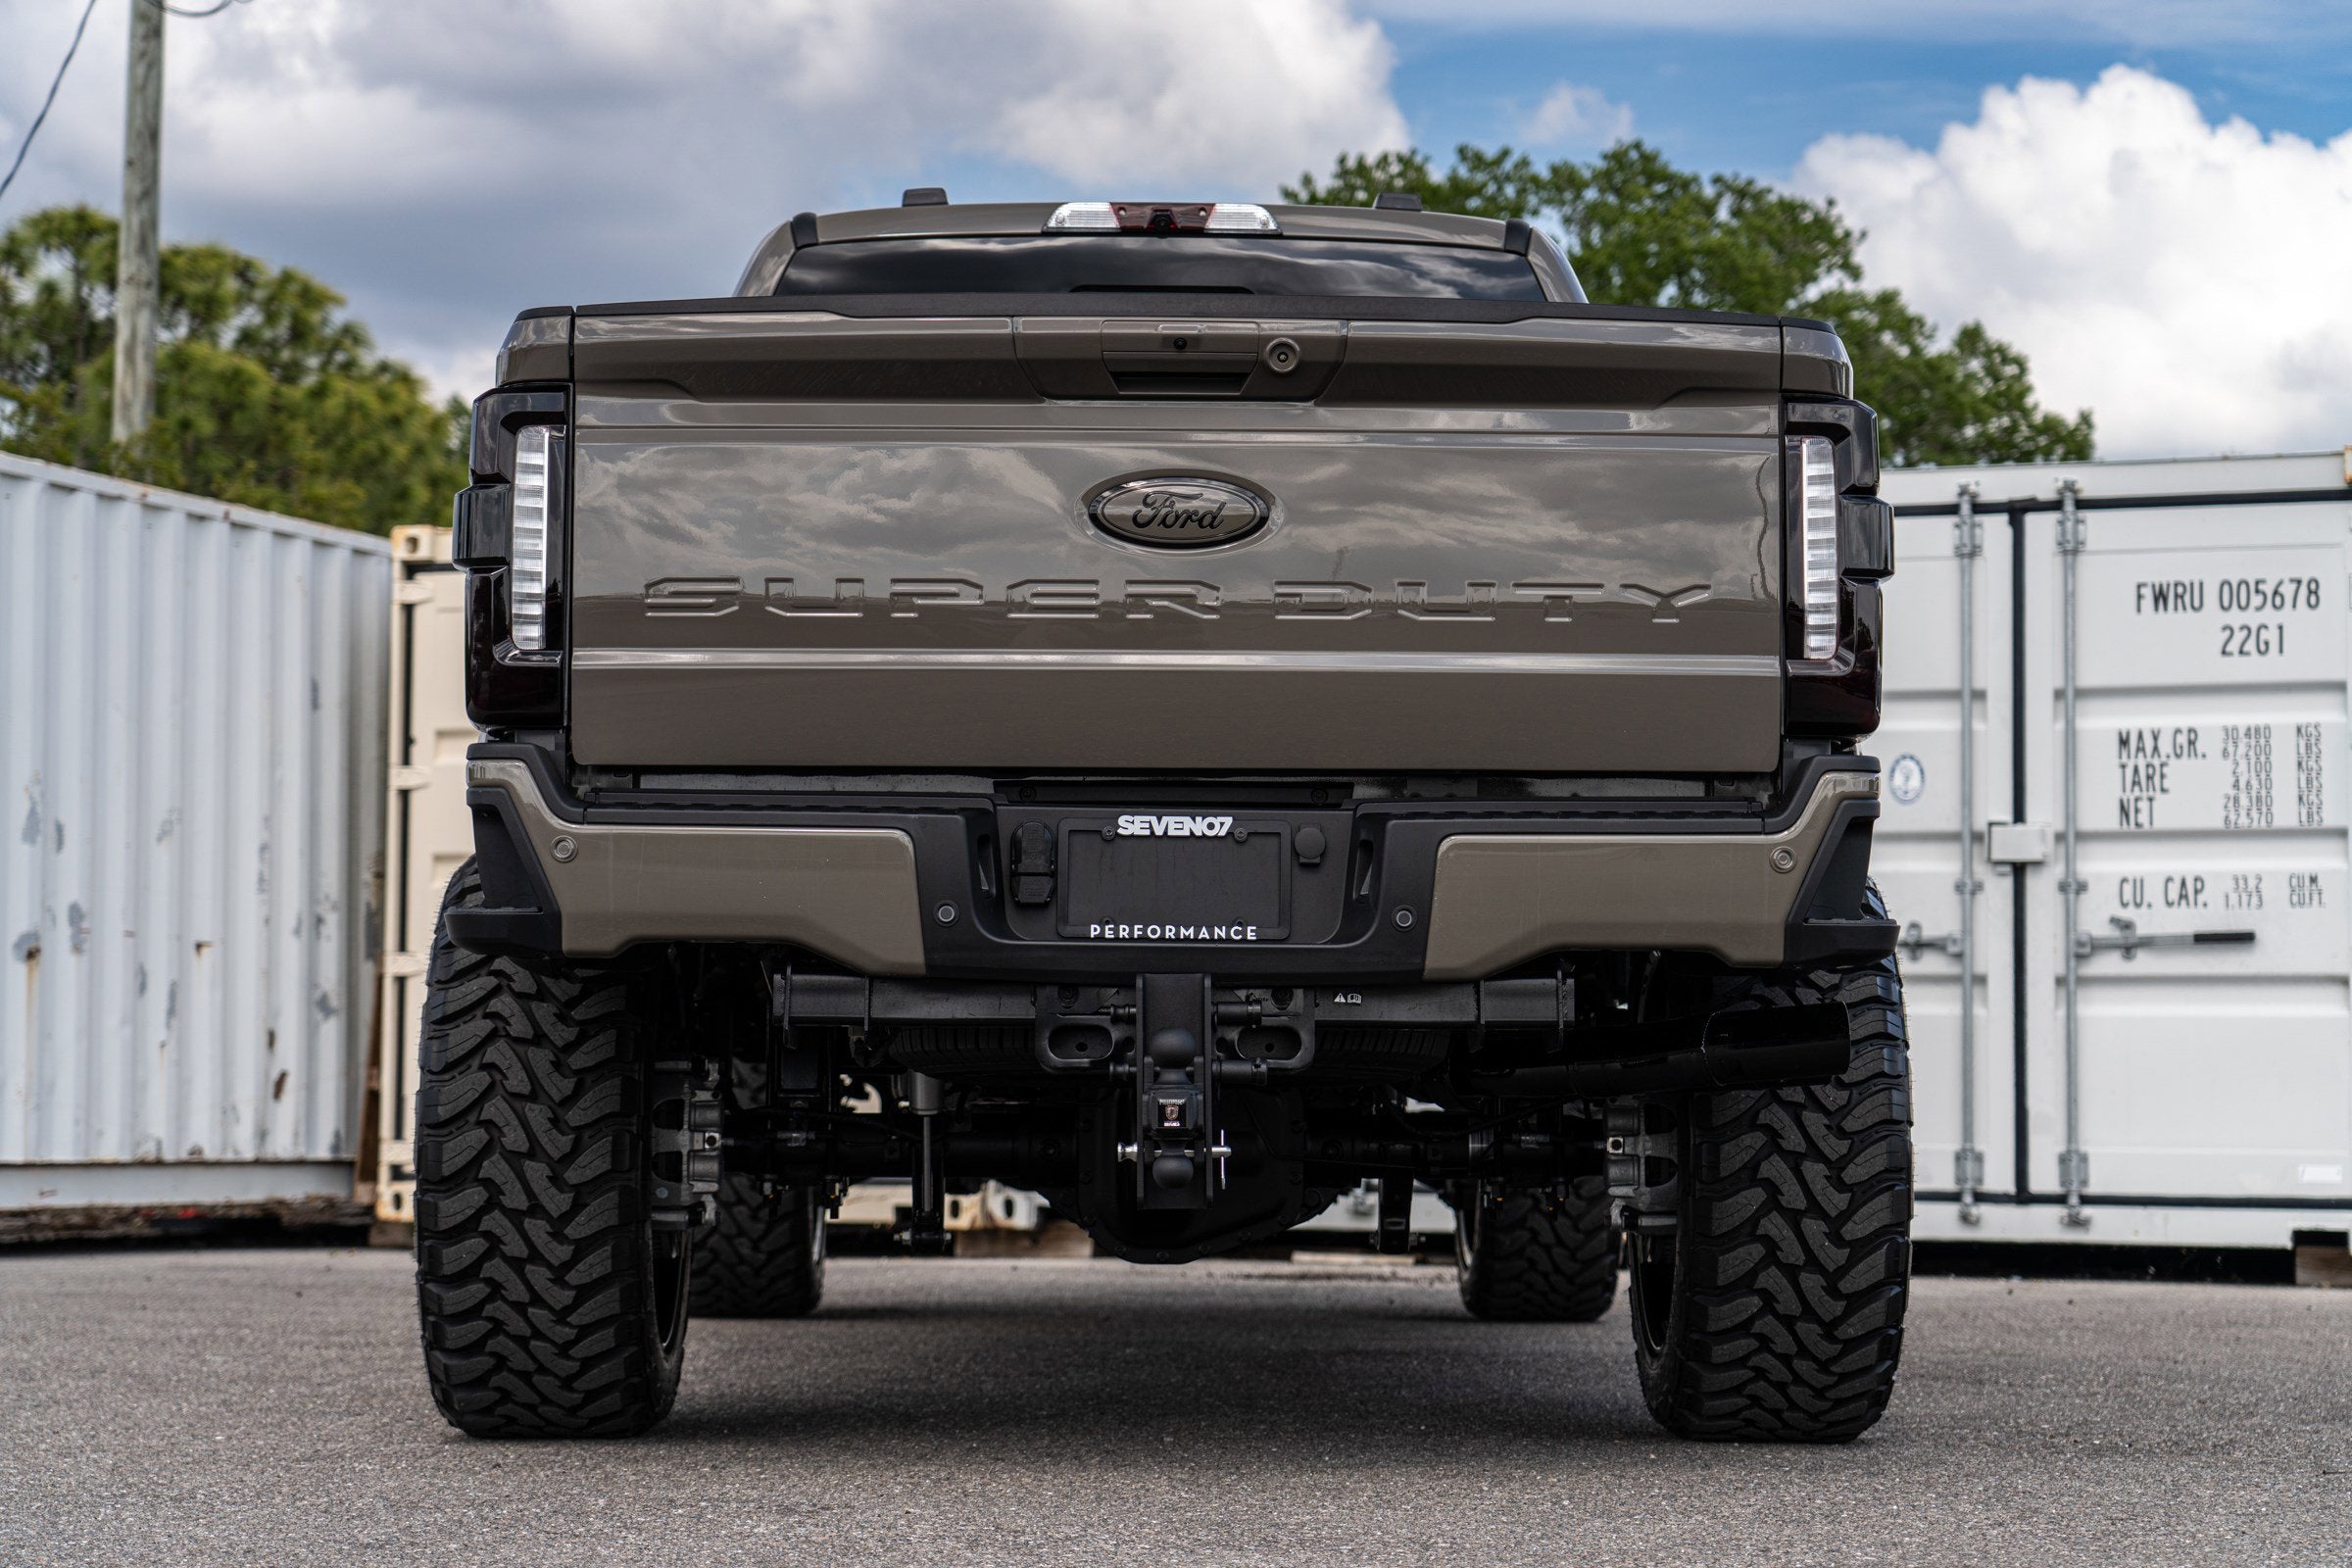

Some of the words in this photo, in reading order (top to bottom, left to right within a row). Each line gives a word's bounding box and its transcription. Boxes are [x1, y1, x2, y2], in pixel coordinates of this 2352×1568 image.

[1132, 490, 1227, 530] Ford
[644, 576, 1222, 618] SUPER
[1274, 580, 1712, 622] DUTY
[2135, 580, 2204, 614] FWRU
[2218, 577, 2321, 612] 005678
[2220, 623, 2285, 657] 22G1
[2117, 728, 2207, 760] MAX.GR.
[2119, 762, 2170, 794] TARE
[2119, 797, 2156, 829] NET
[2119, 877, 2153, 908] CU.
[2164, 875, 2208, 908] CAP.
[1089, 923, 1258, 941] PERFORMANCE
